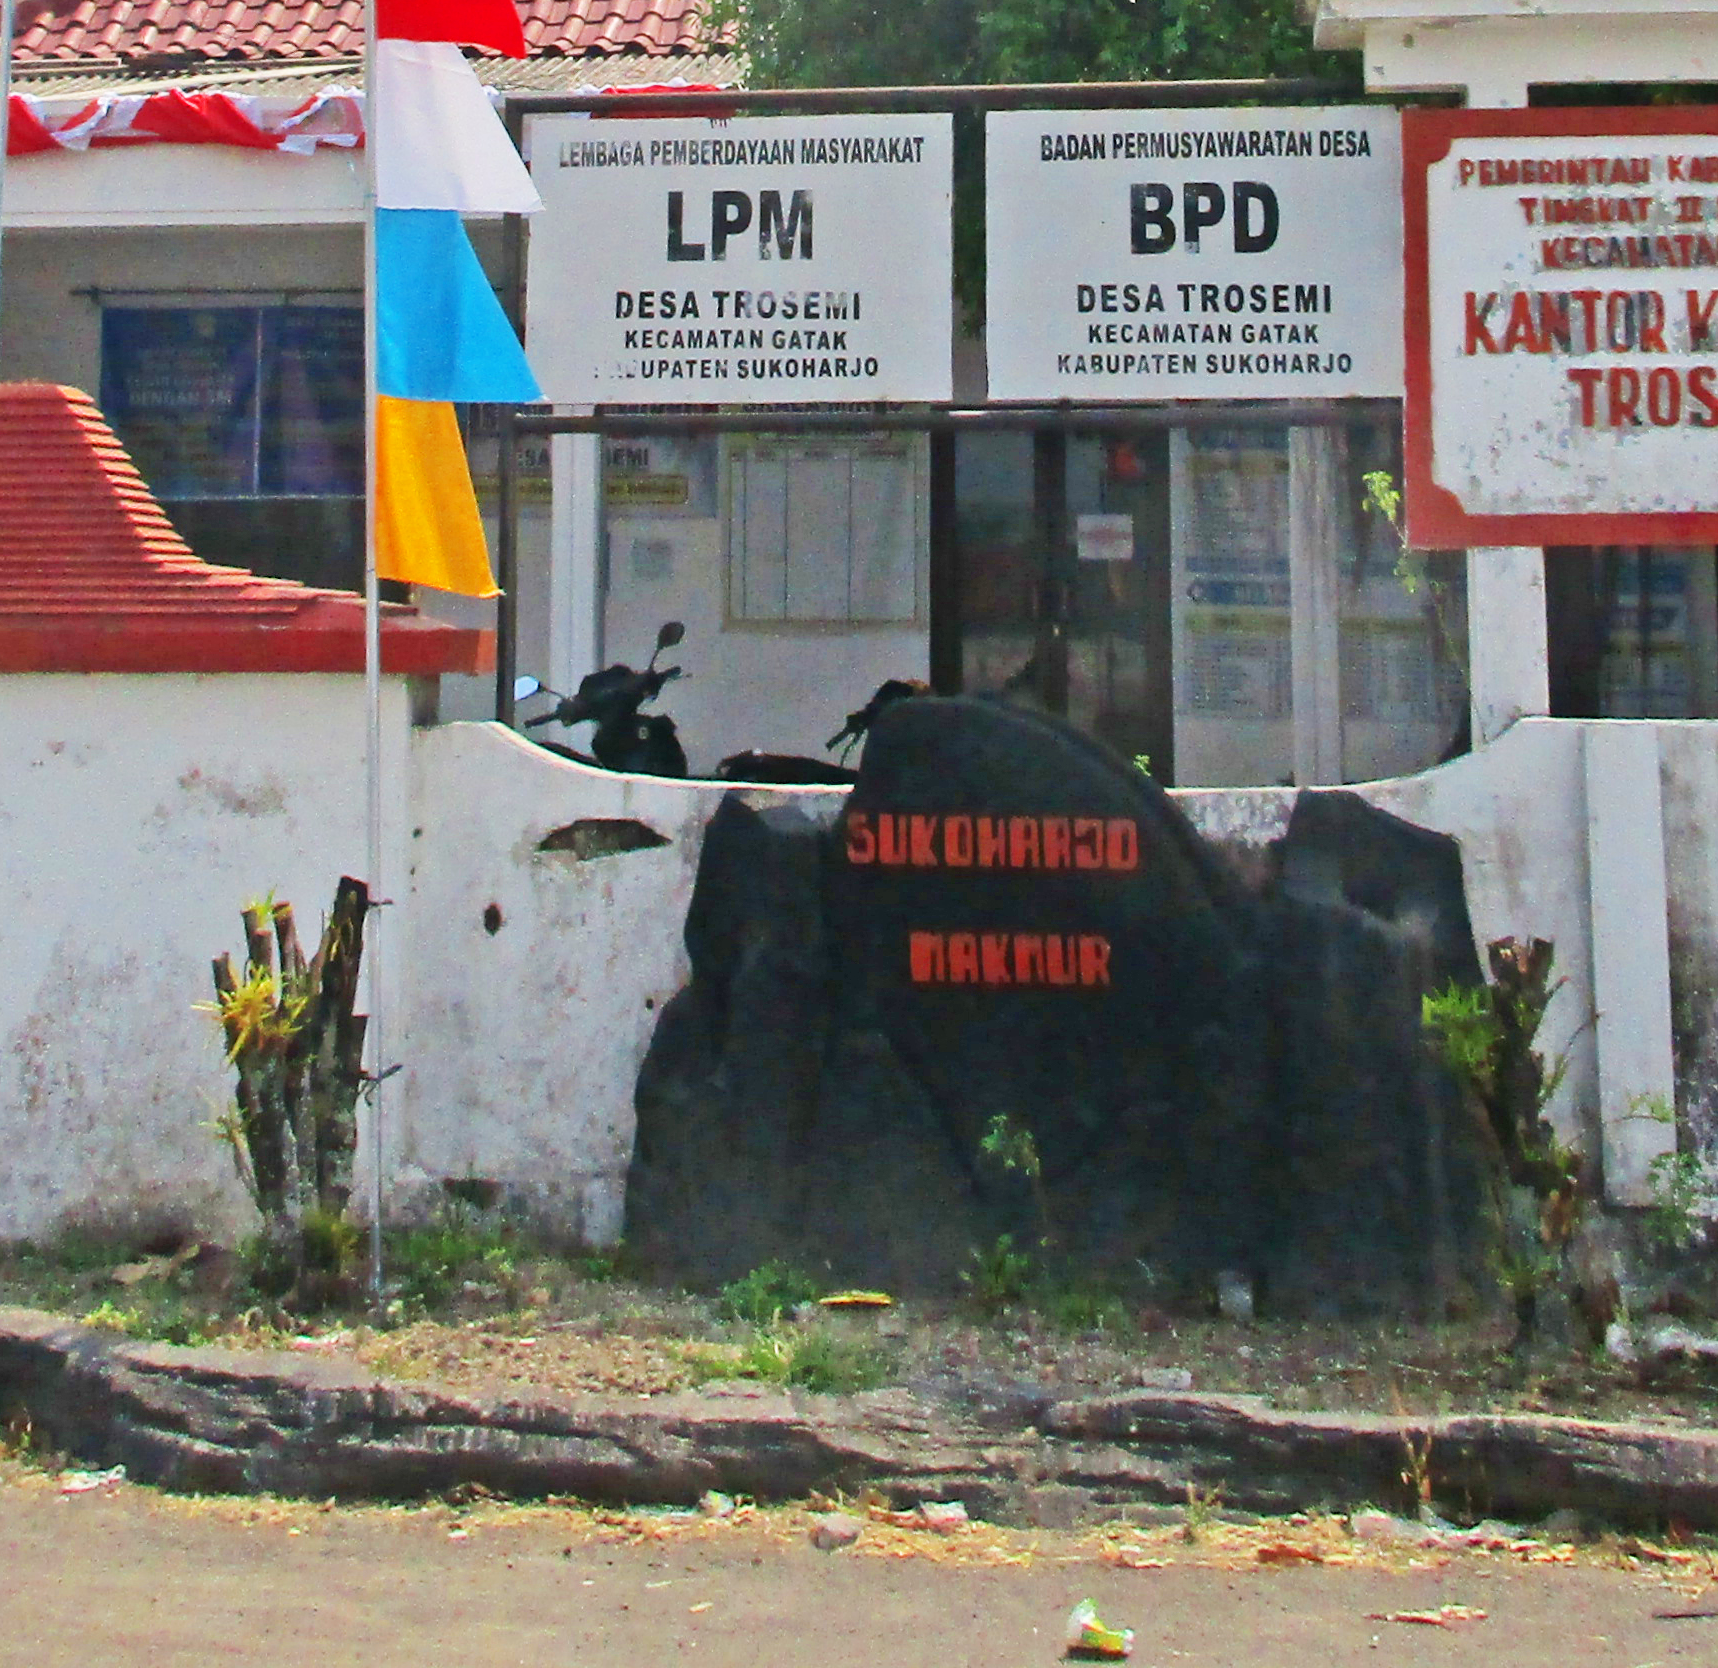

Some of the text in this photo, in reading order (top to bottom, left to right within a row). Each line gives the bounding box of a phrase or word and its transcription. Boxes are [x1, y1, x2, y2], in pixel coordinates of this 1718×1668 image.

[559, 137, 924, 168] LEMBAGA PEMBERDAYAAN MASYARAKAT
[1041, 130, 1371, 161] BADAN PERMUSYAWARATAN DESA
[1459, 157, 1650, 185] PEMERINTAH
[1130, 181, 1280, 254] BPD
[1519, 197, 1652, 224] TINGKAT
[667, 190, 813, 262] LPM
[615, 290, 861, 320] DESA TROSEMI
[1077, 284, 1331, 314] DESA TROSEMI
[1088, 324, 1319, 344] KECAMATAN GATAK
[1464, 290, 1669, 354] KANTOR
[625, 330, 847, 350] KECAMATAN GATAK
[594, 357, 878, 379] UPATEN SUKOHARJO
[1058, 353, 1352, 374] KABUPATEN SUKOHARJO
[846, 810, 1139, 869] SUKOHARJO
[909, 931, 1111, 985] MAKMUR
